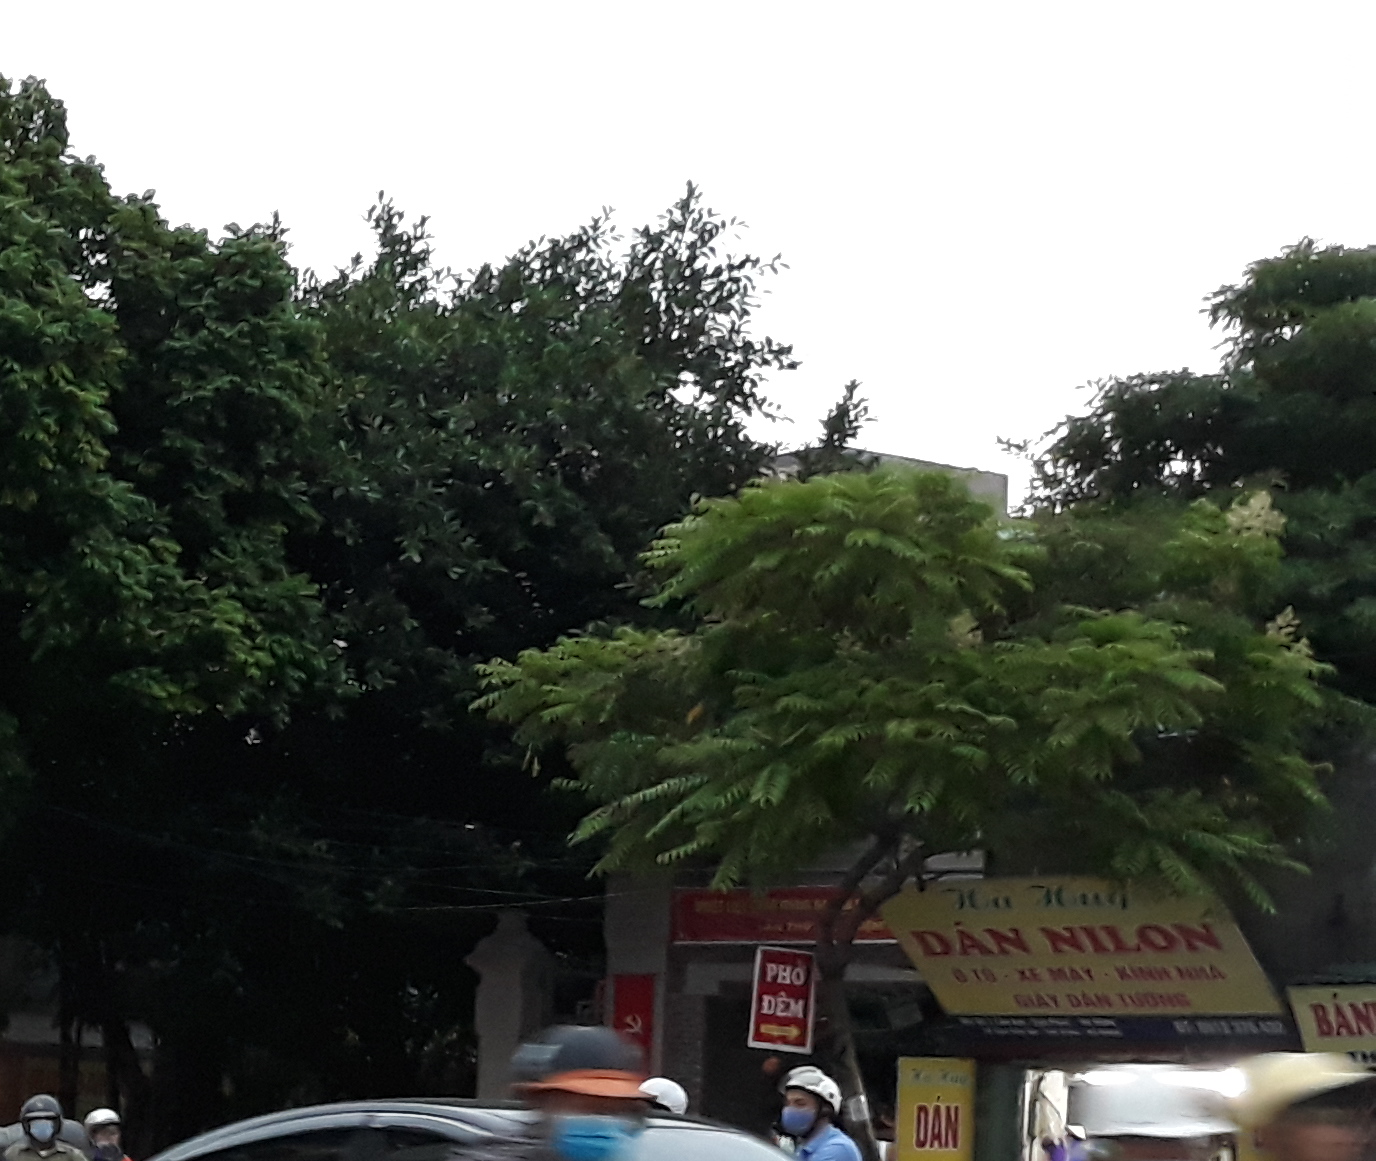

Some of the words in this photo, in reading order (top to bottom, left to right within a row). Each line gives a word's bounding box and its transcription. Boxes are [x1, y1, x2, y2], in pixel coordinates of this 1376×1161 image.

[1039, 921, 1224, 955] NILON
[1016, 967, 1043, 983] XE
[915, 1095, 959, 1149] DÁN
